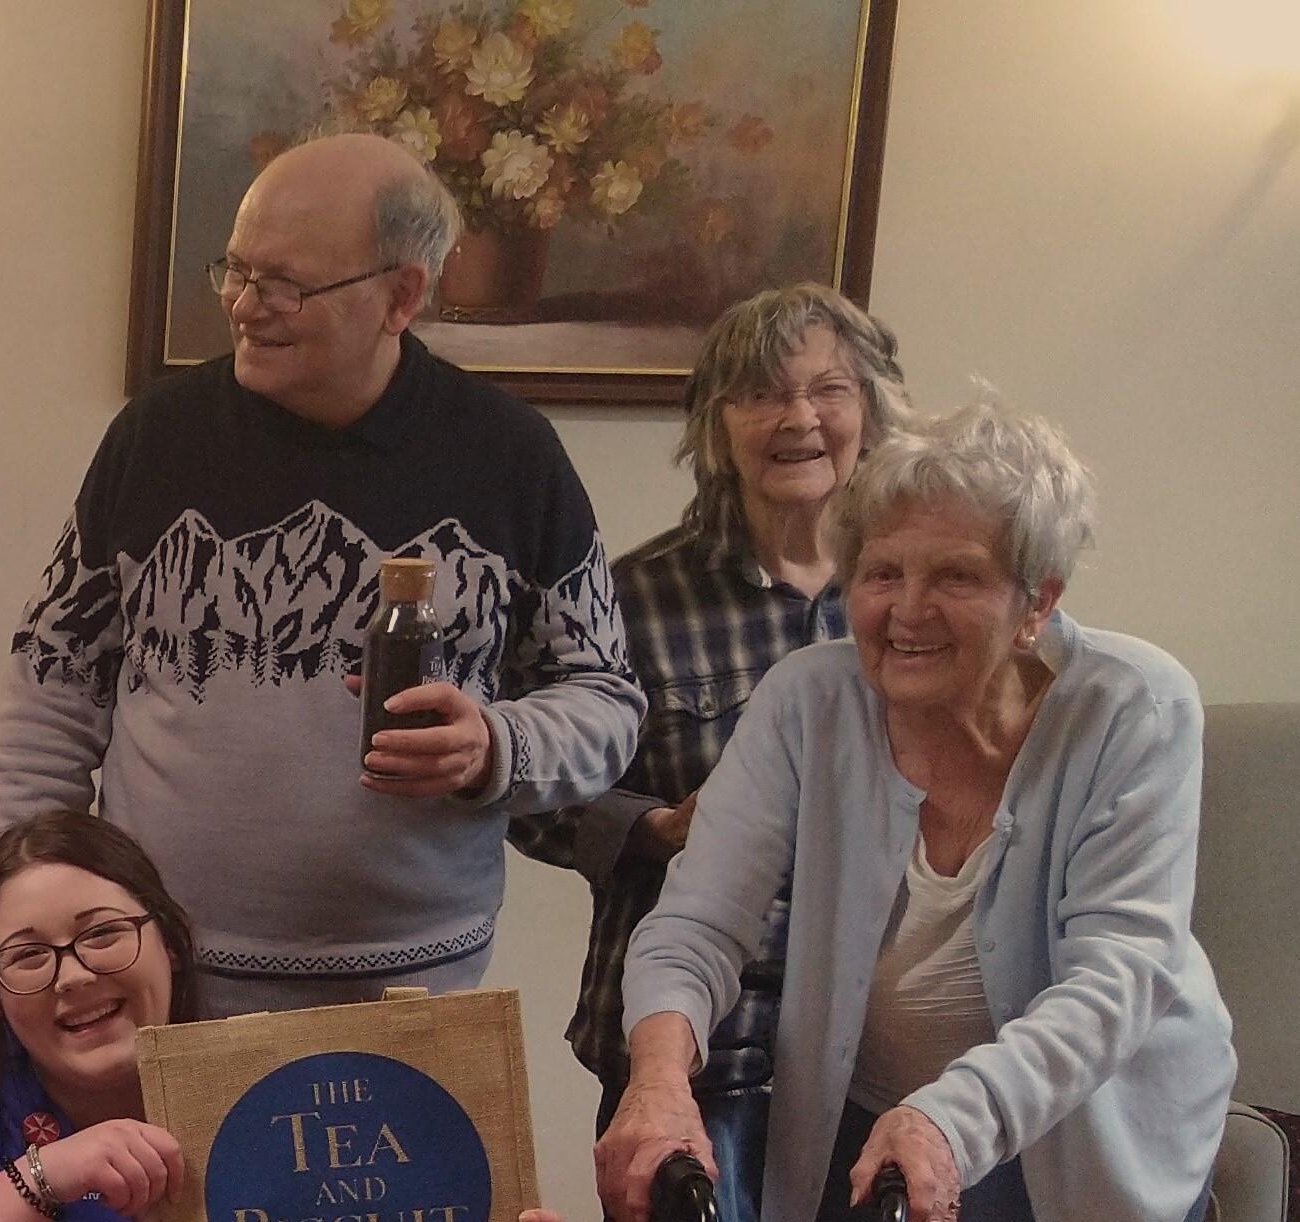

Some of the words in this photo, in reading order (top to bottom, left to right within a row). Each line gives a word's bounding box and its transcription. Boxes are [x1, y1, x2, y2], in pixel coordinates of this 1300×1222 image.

[308, 1078, 372, 1105] THE
[270, 1111, 410, 1173] TEA
[314, 1176, 387, 1207] AND
